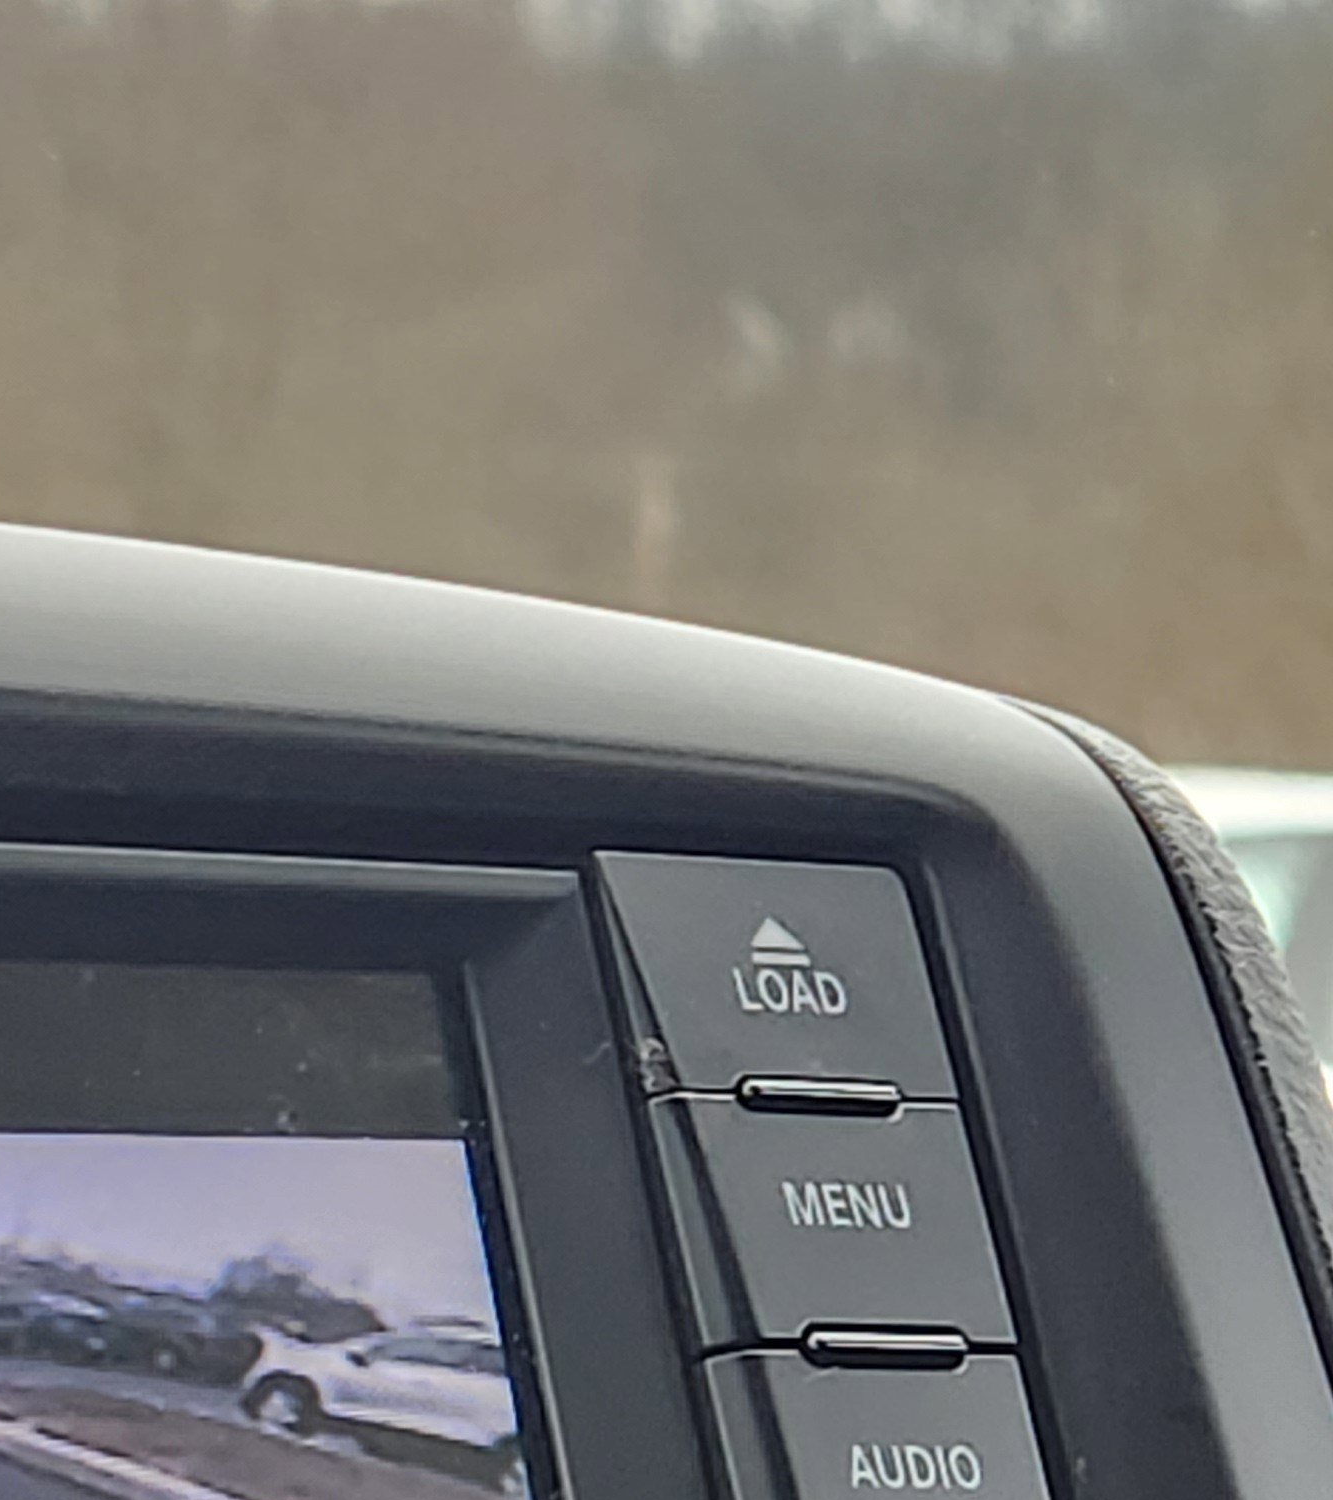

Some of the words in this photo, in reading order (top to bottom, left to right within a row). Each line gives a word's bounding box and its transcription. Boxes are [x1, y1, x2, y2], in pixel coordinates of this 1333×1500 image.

[732, 966, 847, 1015] LOAD
[781, 1181, 912, 1230] MENU
[850, 1444, 982, 1491] AUDIO
